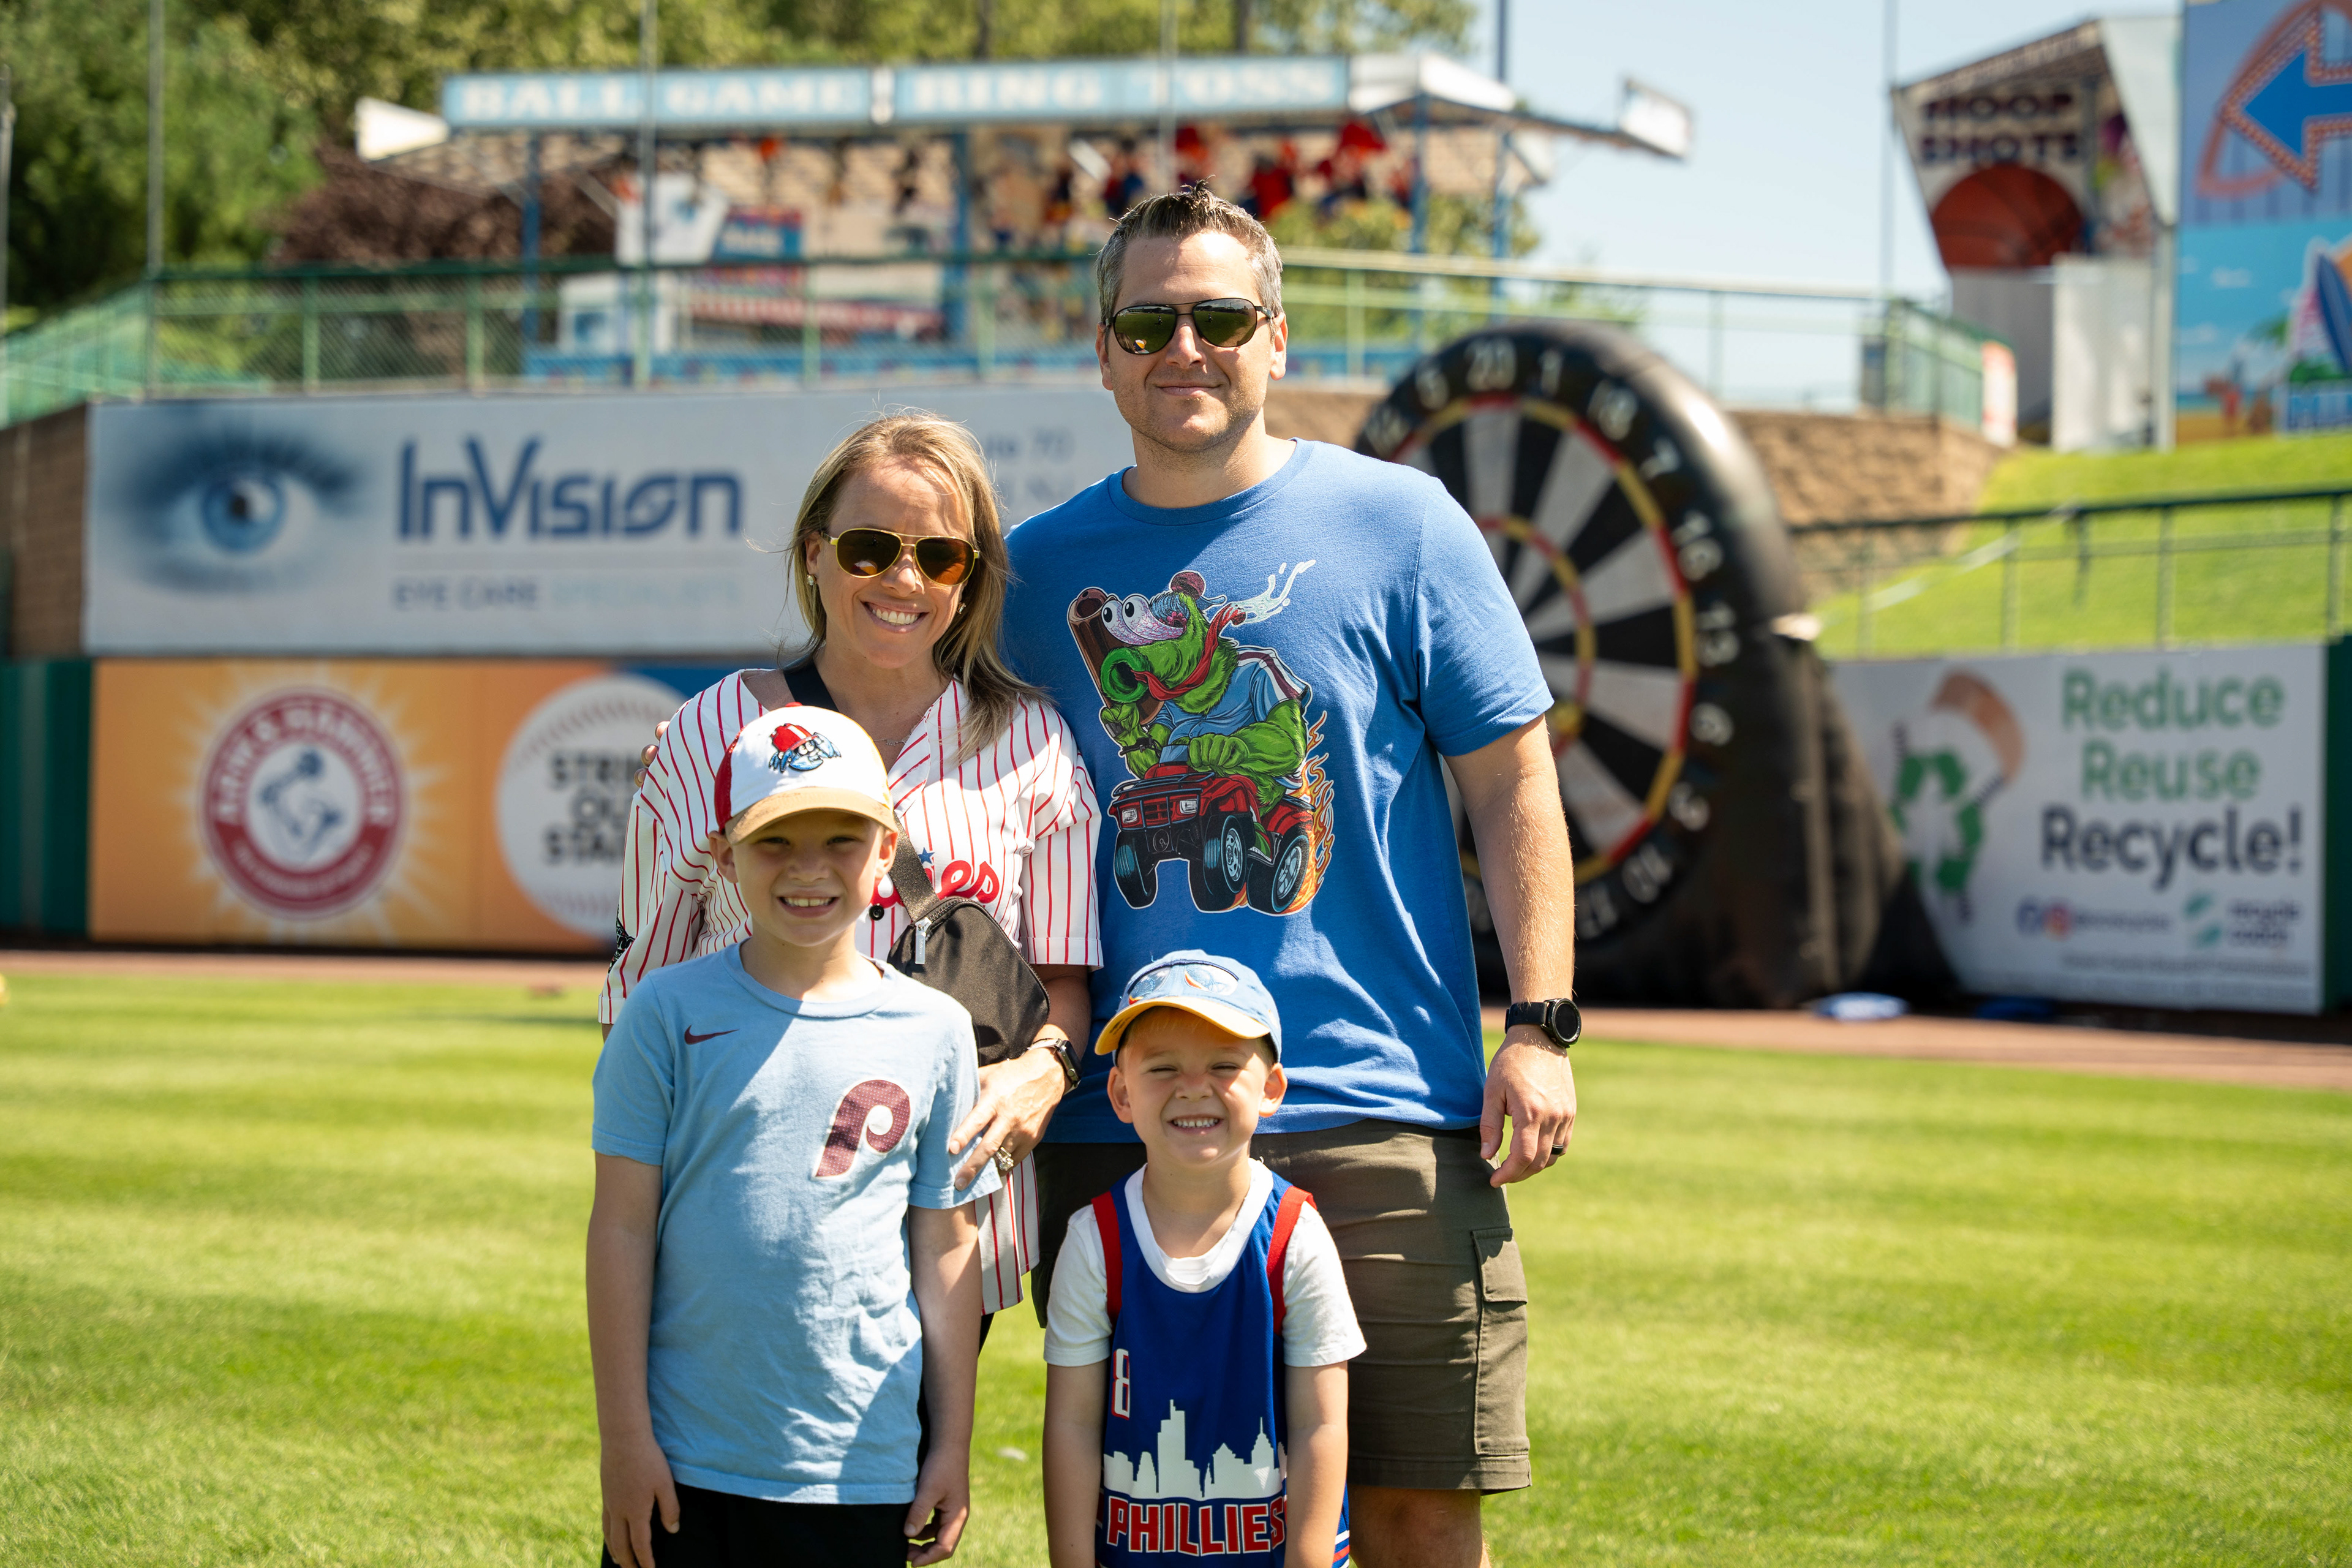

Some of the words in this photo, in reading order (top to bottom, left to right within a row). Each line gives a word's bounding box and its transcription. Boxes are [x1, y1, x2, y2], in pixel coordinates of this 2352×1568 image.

[462, 78, 641, 120] BALL
[663, 75, 856, 116] GAME
[912, 67, 1104, 111] RING
[1128, 60, 1337, 103] TOSS
[1920, 131, 2078, 163] SHOTS
[1466, 337, 1518, 393] 20
[1539, 347, 1564, 398] 1
[398, 435, 746, 539] InVision
[390, 574, 447, 612] EYE
[457, 574, 541, 612] CARE
[2060, 669, 2285, 730] Reduce
[548, 750, 648, 788] STRI
[2080, 739, 2262, 802] Reuse
[571, 790, 633, 826] OU
[2041, 804, 2304, 894] Recycle!
[812, 1077, 913, 1179] P
[1106, 1495, 1286, 1557] PHILLIES
